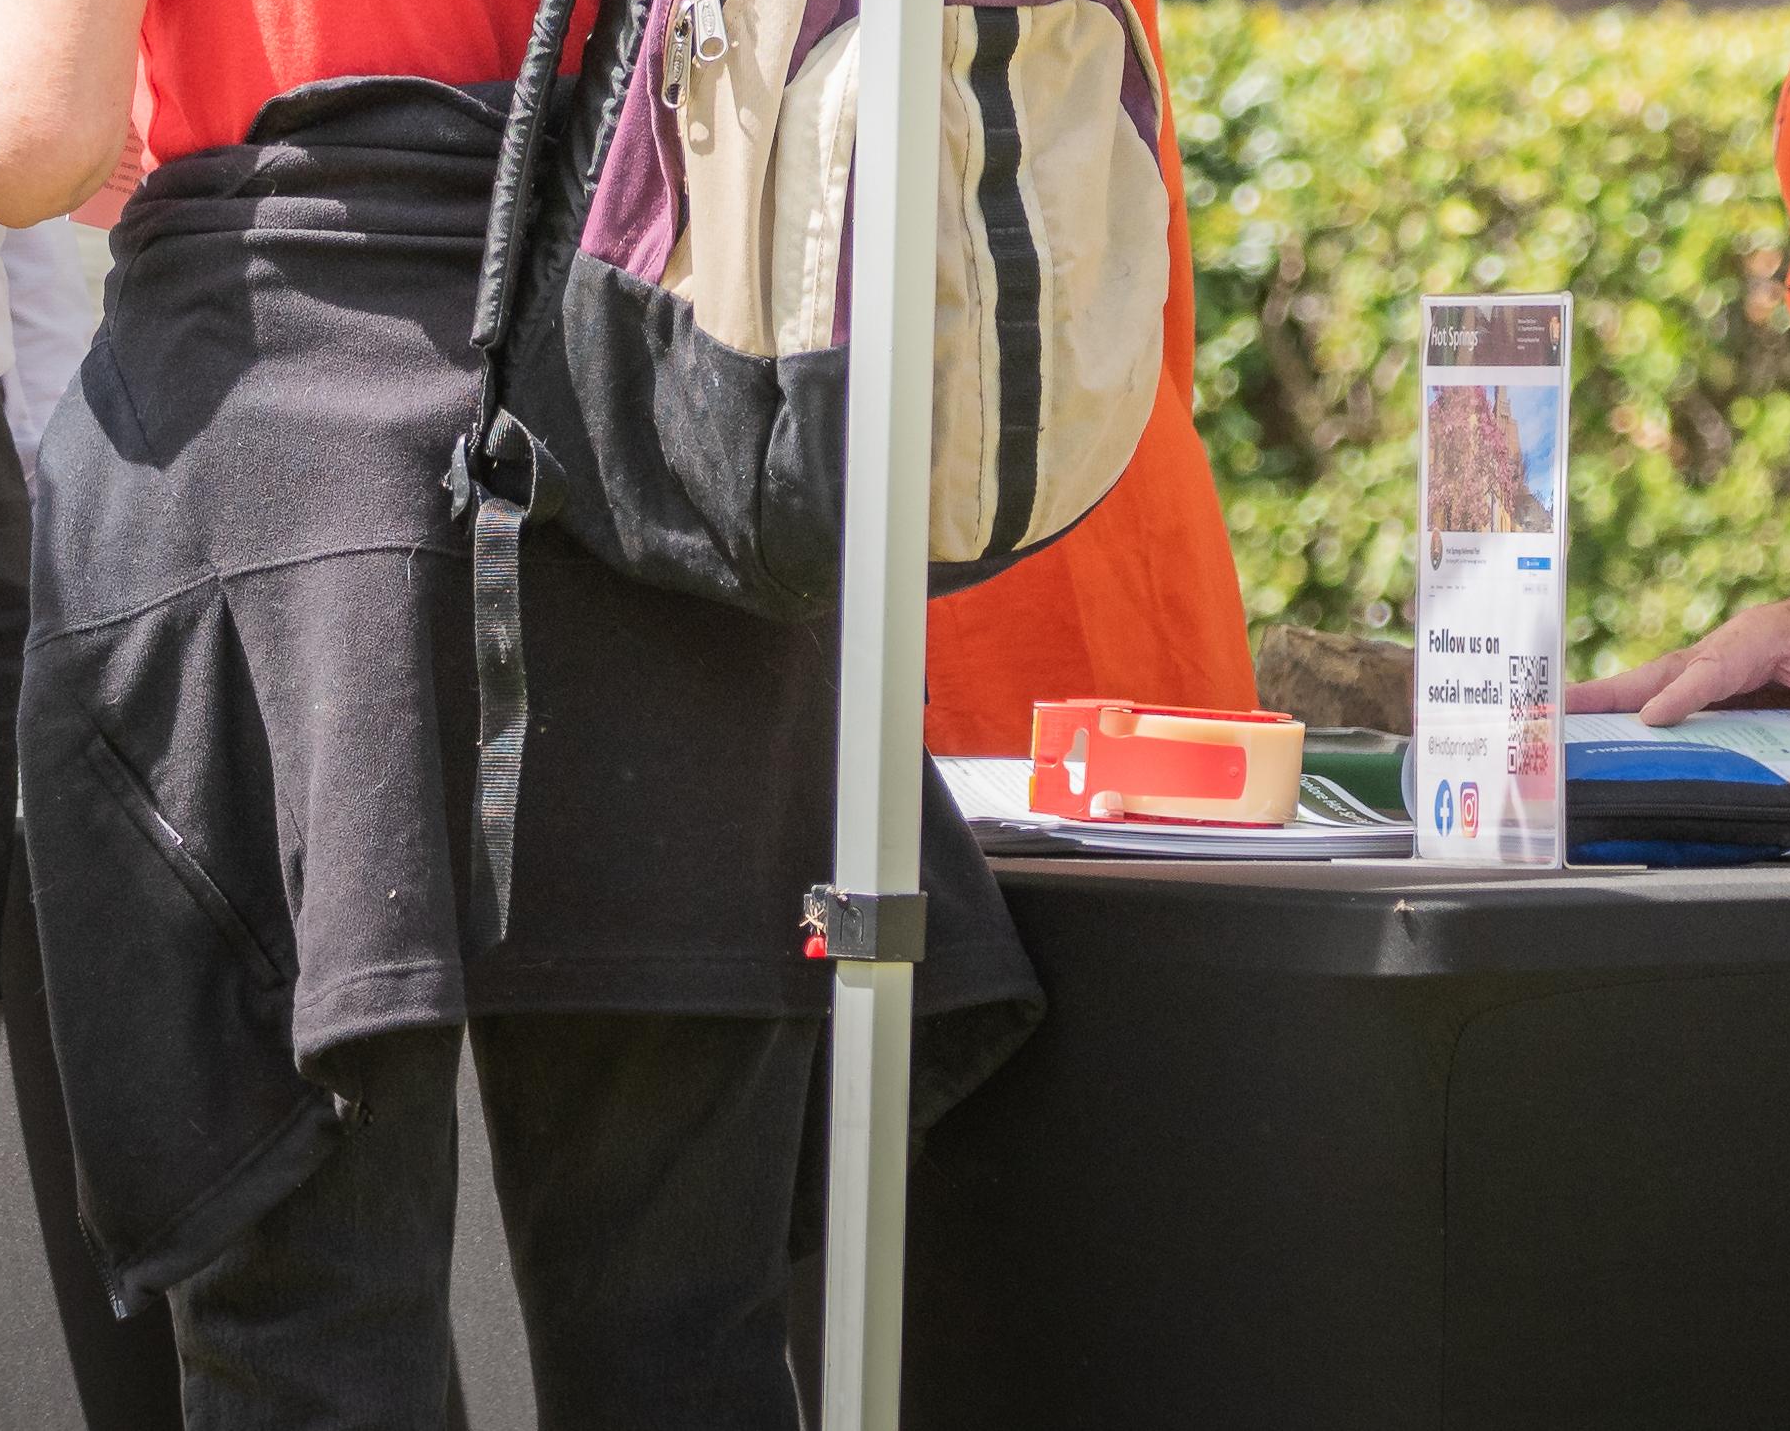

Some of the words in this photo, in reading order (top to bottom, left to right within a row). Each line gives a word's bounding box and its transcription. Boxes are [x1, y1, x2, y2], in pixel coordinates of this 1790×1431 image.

[1430, 326, 1447, 347] Hot
[1448, 325, 1479, 351] Springs
[1428, 628, 1466, 654] Follow
[1469, 636, 1482, 654] us
[1485, 636, 1500, 654] on
[1428, 678, 1460, 704] social
[1463, 679, 1503, 705] media!
